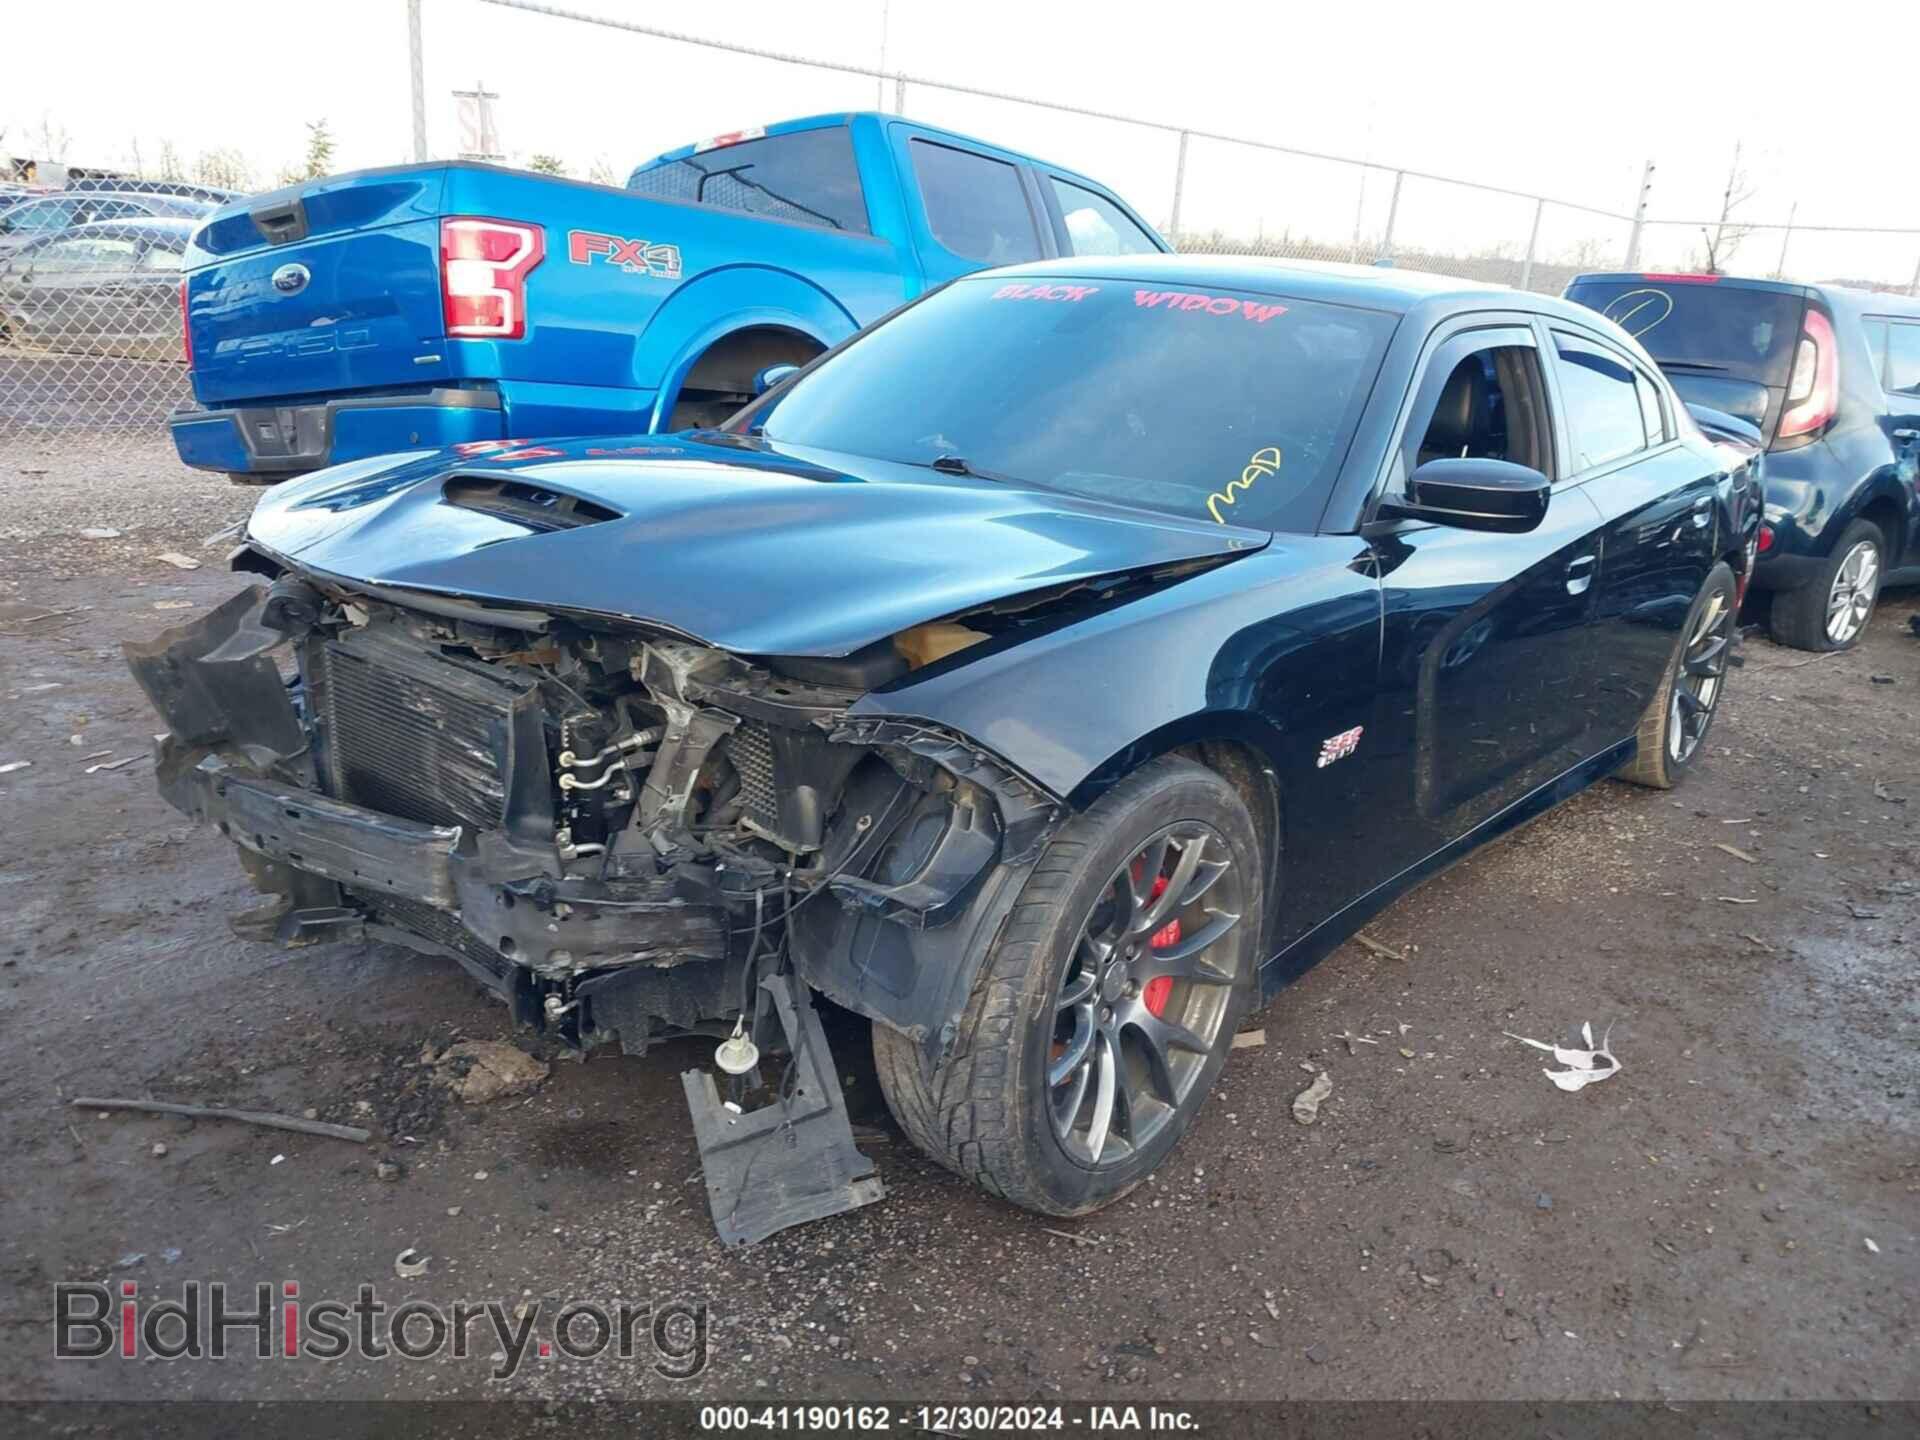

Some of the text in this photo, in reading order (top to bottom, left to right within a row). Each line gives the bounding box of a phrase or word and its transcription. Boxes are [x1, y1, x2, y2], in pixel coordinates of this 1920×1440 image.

[568, 229, 682, 273] FX4
[991, 284, 1289, 322] BLACK WIDOW
